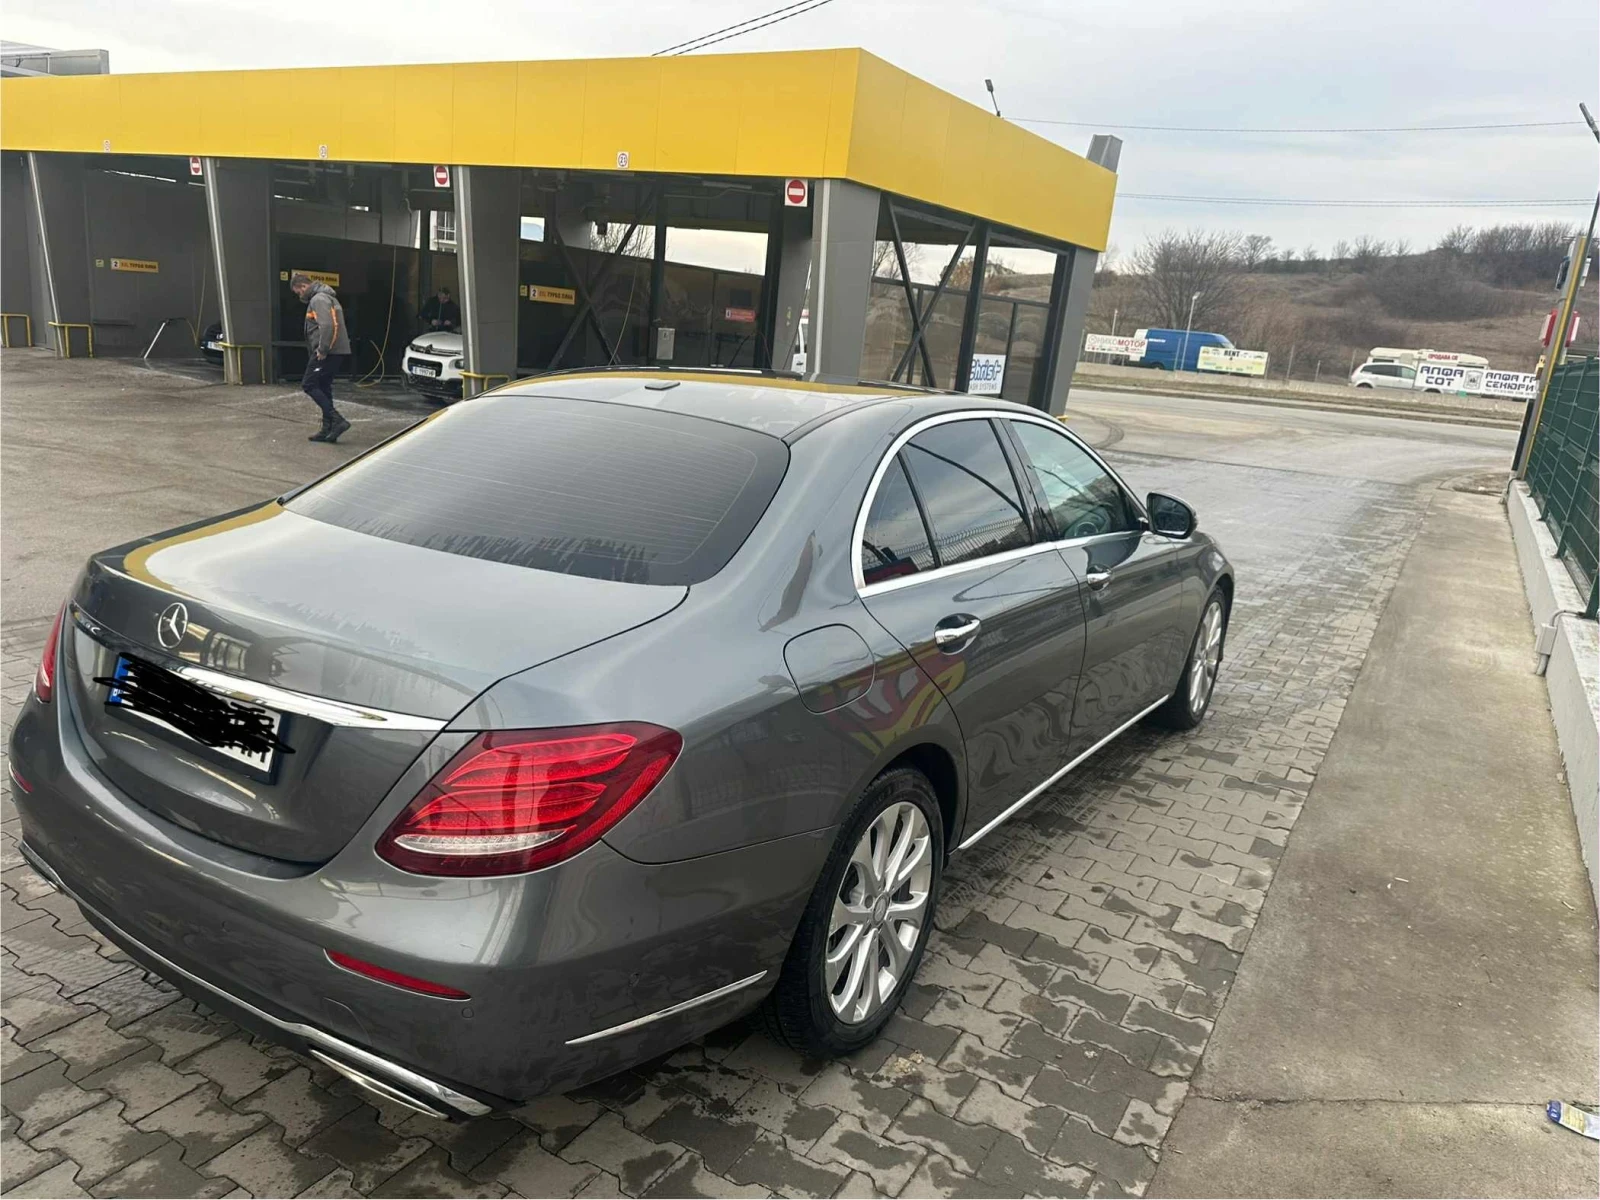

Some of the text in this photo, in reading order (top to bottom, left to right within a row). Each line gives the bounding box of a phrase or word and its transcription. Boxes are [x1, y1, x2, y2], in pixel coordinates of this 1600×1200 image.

[532, 289, 537, 298] 2
[1425, 376, 1455, 386] СОТ
[1523, 375, 1537, 383] ГР
[1485, 381, 1535, 392] СЕКЮРИ
